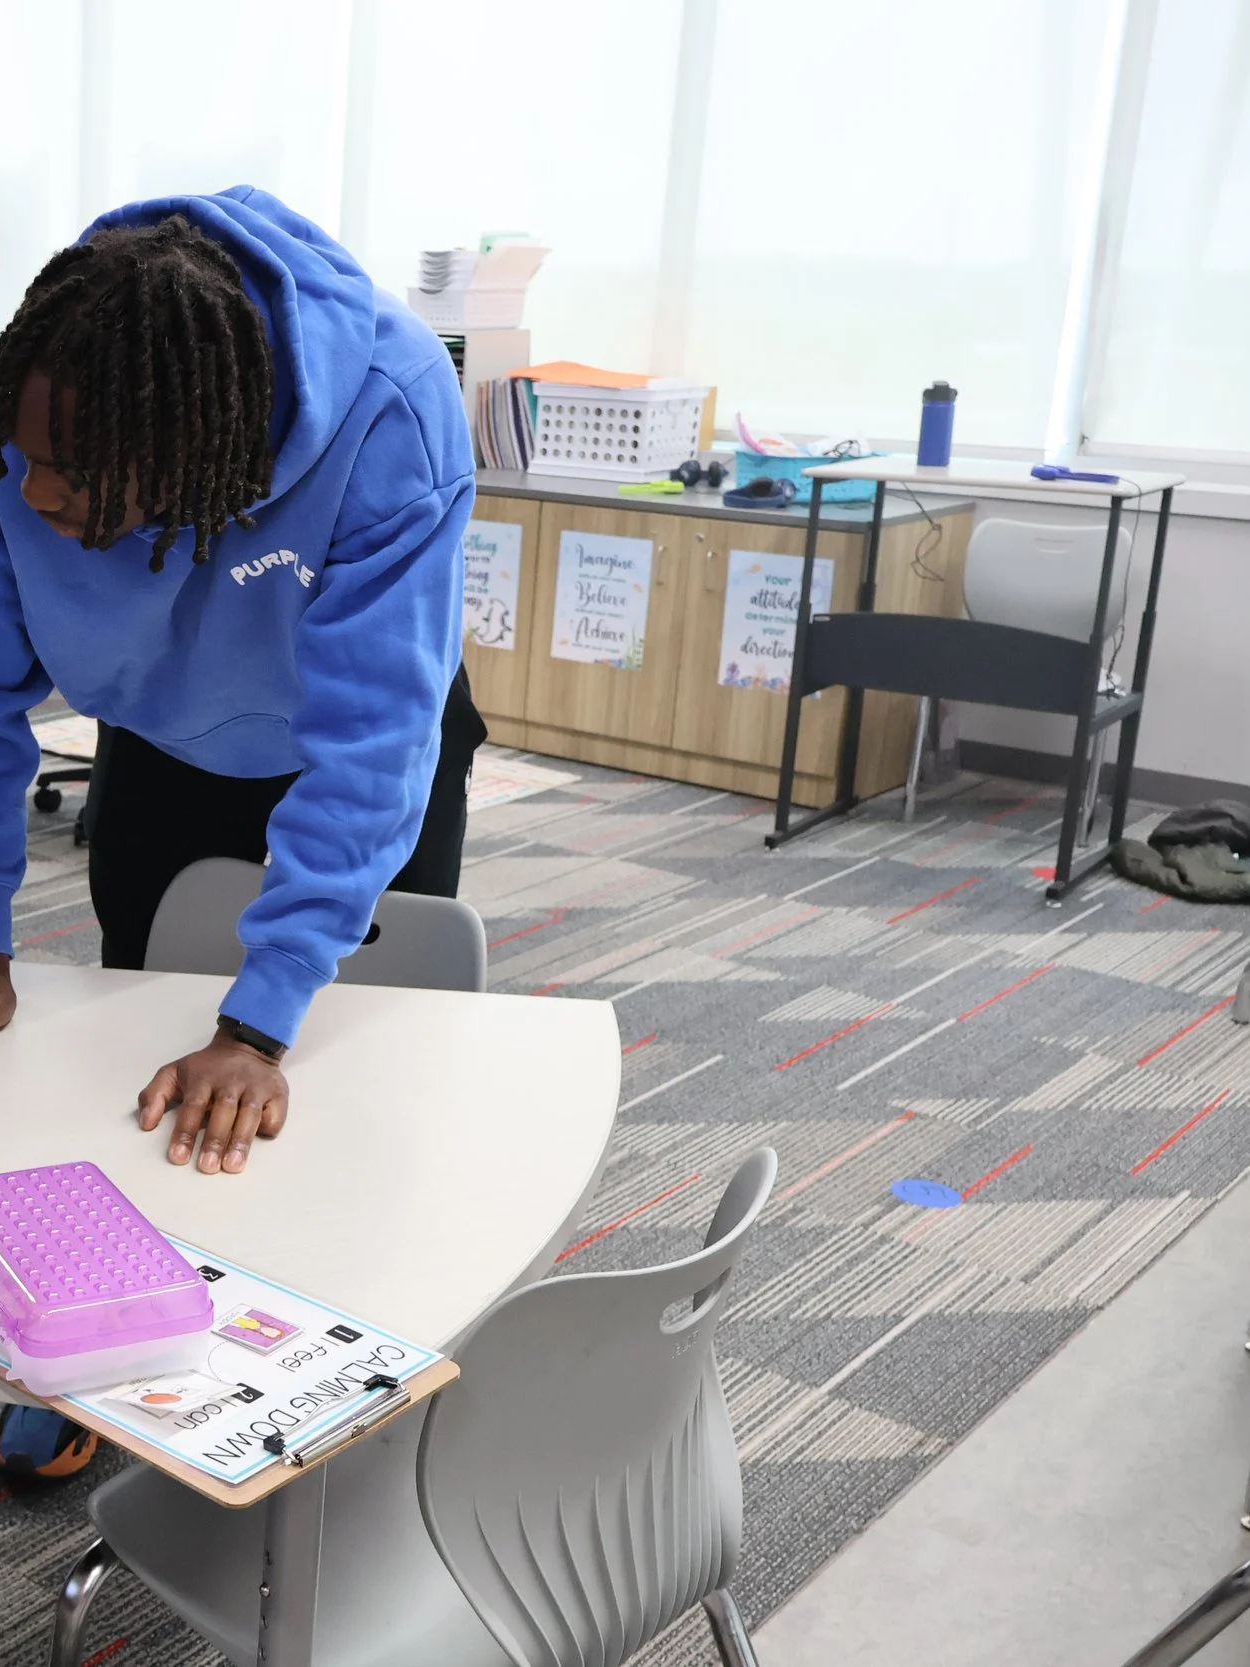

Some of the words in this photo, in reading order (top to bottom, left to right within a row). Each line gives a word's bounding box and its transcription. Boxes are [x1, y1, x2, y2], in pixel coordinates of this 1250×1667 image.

[575, 543, 635, 575] Imagine
[575, 581, 627, 608] Believe
[572, 616, 626, 642] Achieve
[330, 1326, 358, 1343] 1
[276, 1343, 327, 1373] feel
[289, 1344, 406, 1413] CALMING
[174, 1403, 222, 1430] can
[202, 1408, 301, 1466] DOWN
